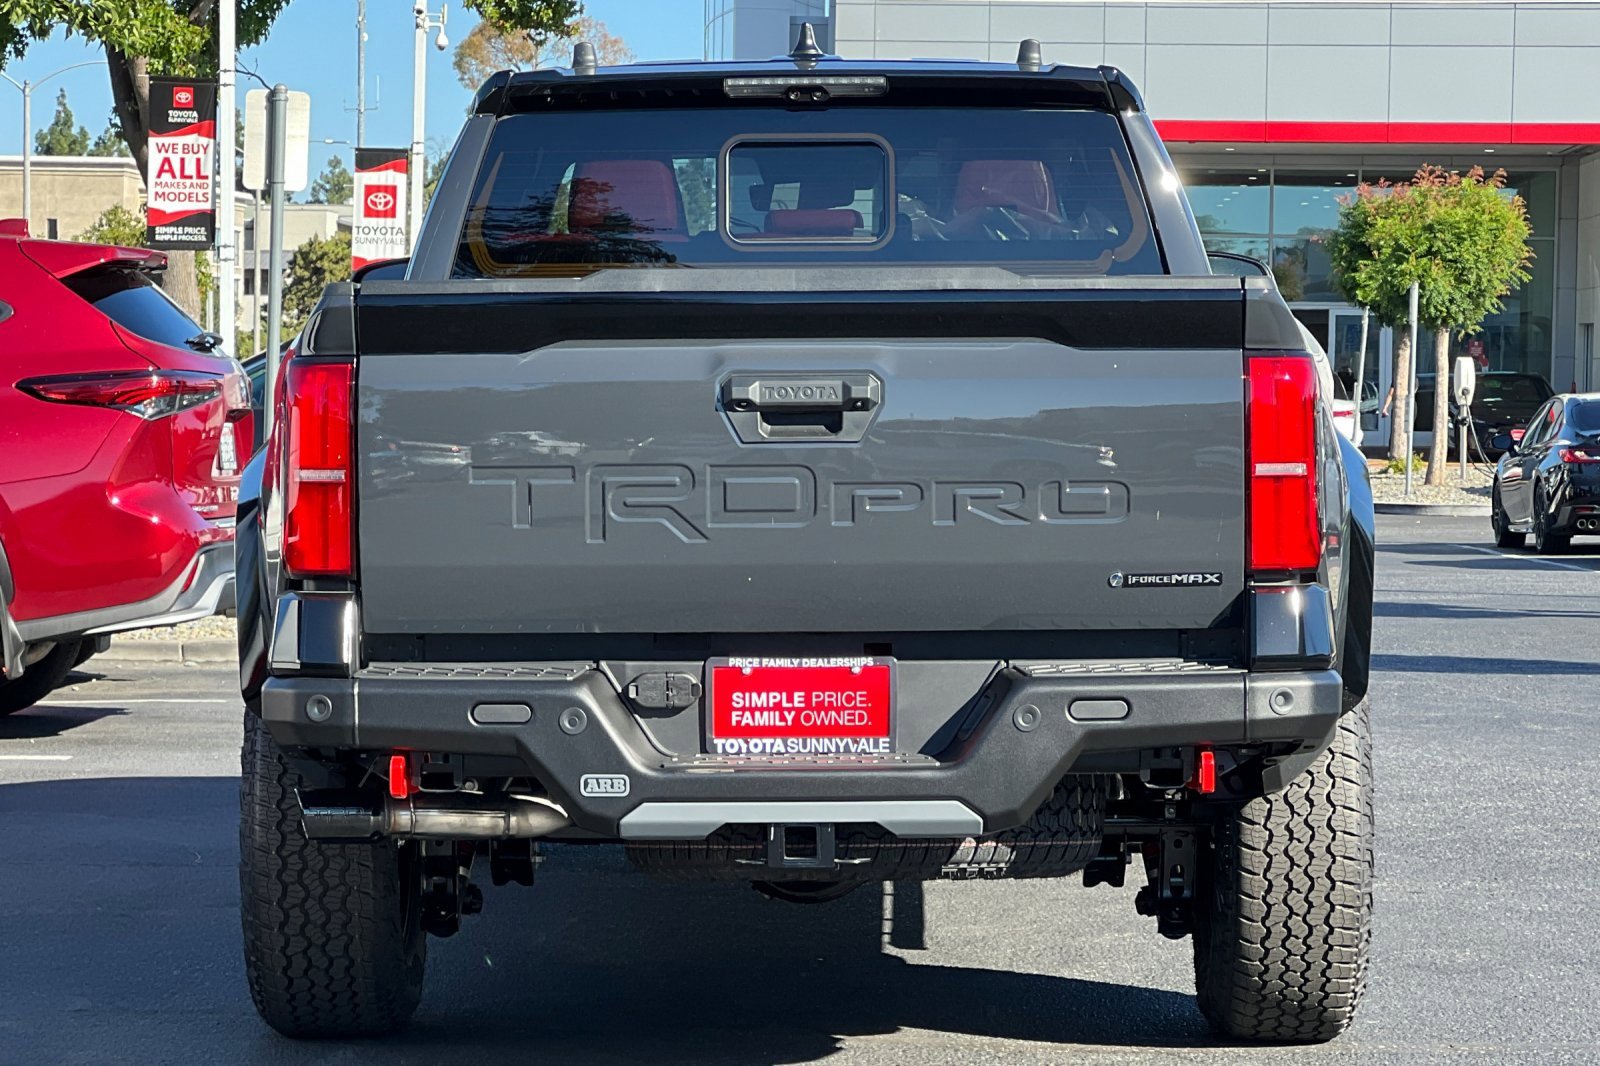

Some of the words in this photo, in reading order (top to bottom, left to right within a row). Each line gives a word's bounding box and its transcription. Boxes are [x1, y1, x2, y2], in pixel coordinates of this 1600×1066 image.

[156, 142, 179, 154] WE
[182, 143, 210, 155] BUY
[155, 157, 209, 180] ALL
[154, 181, 187, 189] MAKES
[189, 181, 209, 189] AND
[154, 191, 209, 203] MODELS
[155, 226, 183, 234] SIMPLE
[184, 226, 207, 235] PRICE.
[354, 226, 404, 236] TOYOTA
[354, 236, 405, 246] SUNNYVALE
[763, 386, 839, 400] TOYOTA
[728, 658, 760, 668] PRICE
[762, 658, 800, 667] FAMILY
[802, 657, 874, 668] DEALERSHIPS
[731, 691, 805, 708] SIMPLE
[811, 691, 872, 708] PRICE.
[731, 710, 796, 726] FAMILY
[800, 710, 872, 726] OWNED.
[585, 778, 626, 793] ARB
